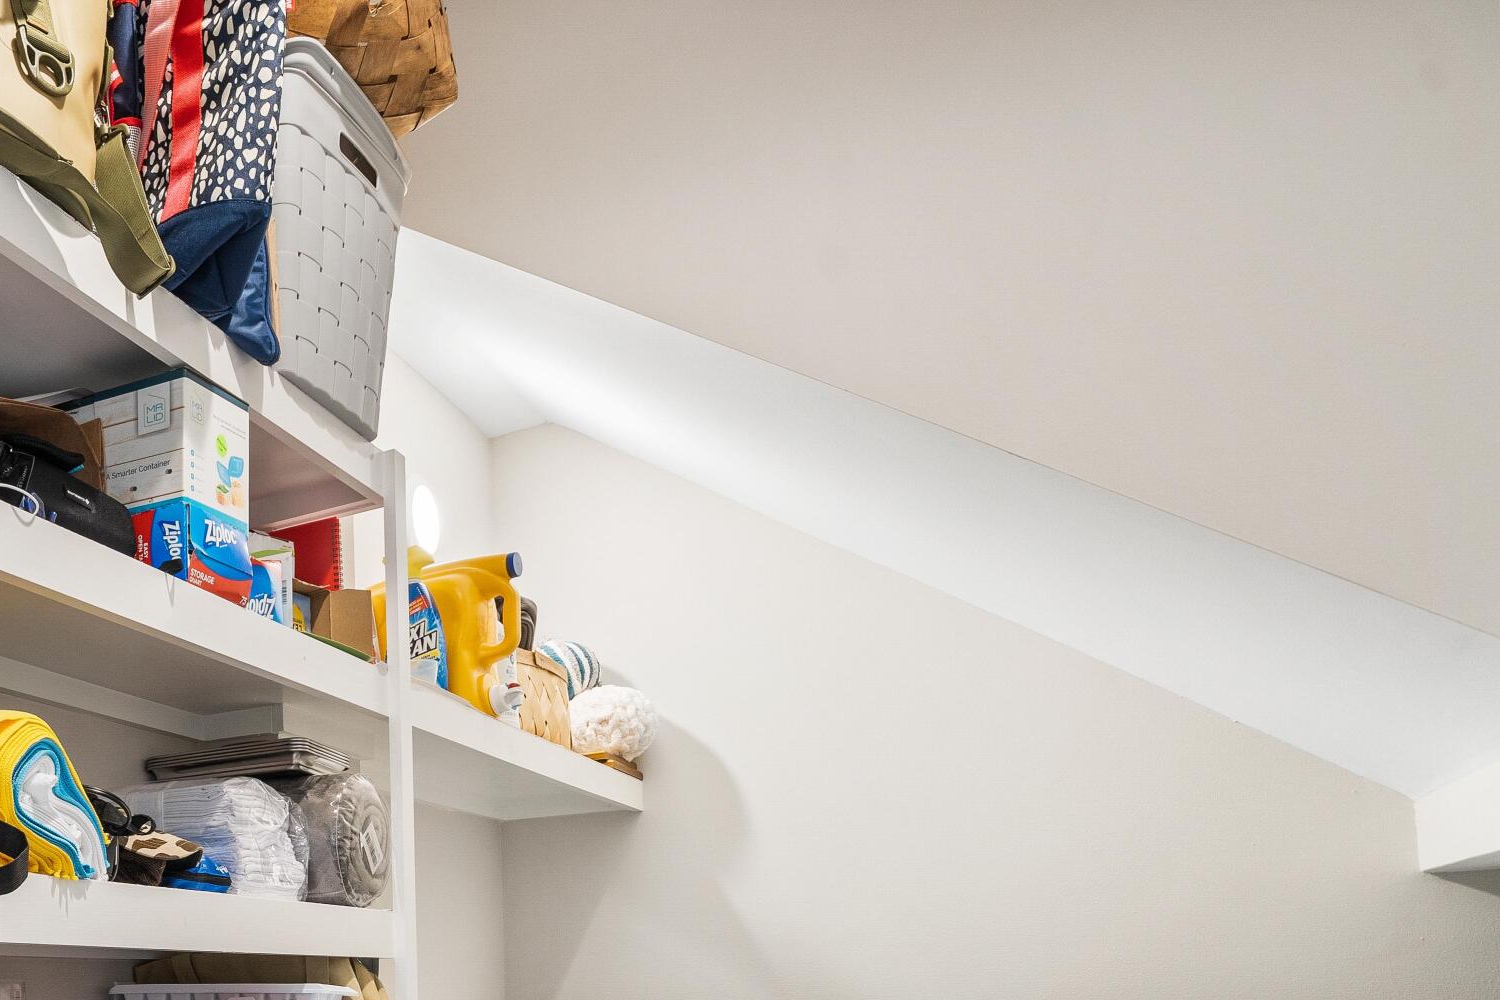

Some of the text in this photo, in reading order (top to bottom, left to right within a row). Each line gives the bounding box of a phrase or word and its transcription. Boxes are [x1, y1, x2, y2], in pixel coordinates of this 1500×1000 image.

[146, 403, 163, 414] MR
[146, 413, 163, 423] LID
[112, 467, 137, 479] Smarter
[138, 459, 171, 473] Container
[204, 519, 237, 548] Ziploc
[190, 569, 215, 585] STORAGE
